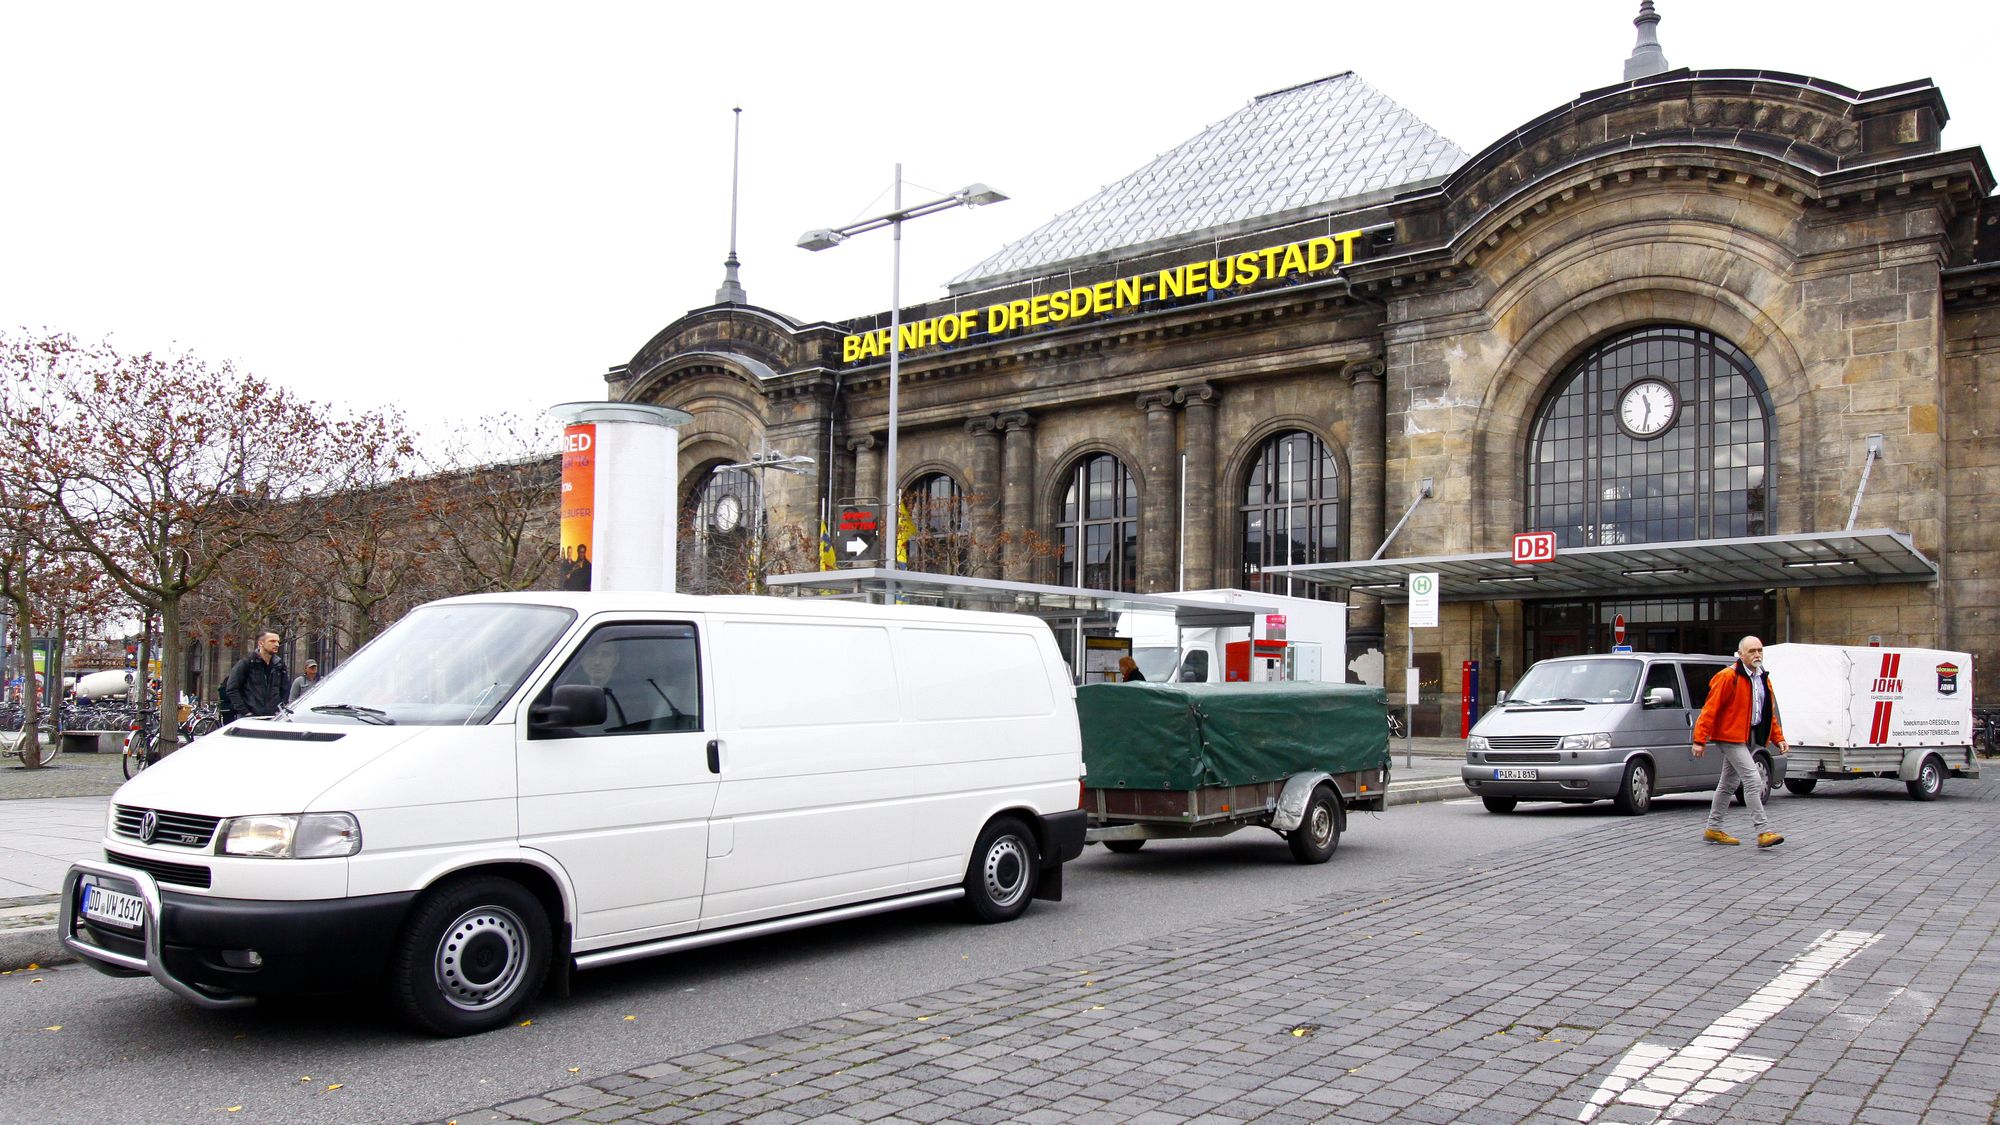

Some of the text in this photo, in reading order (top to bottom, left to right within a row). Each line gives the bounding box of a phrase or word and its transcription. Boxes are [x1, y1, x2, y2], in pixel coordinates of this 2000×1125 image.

[843, 229, 1363, 362] BAHNHOF DRESDEN-NEUSTADT
[1518, 537, 1549, 558] DB
[1417, 579, 1427, 591] H
[1871, 679, 1903, 692] JOHN
[1892, 729, 1960, 737] boeckmann-SENFTENBERG.com
[1499, 770, 1513, 779] PIR
[1522, 770, 1536, 779] 815
[89, 889, 101, 912] DD
[106, 893, 119, 916] VW
[118, 897, 143, 922] 1617
